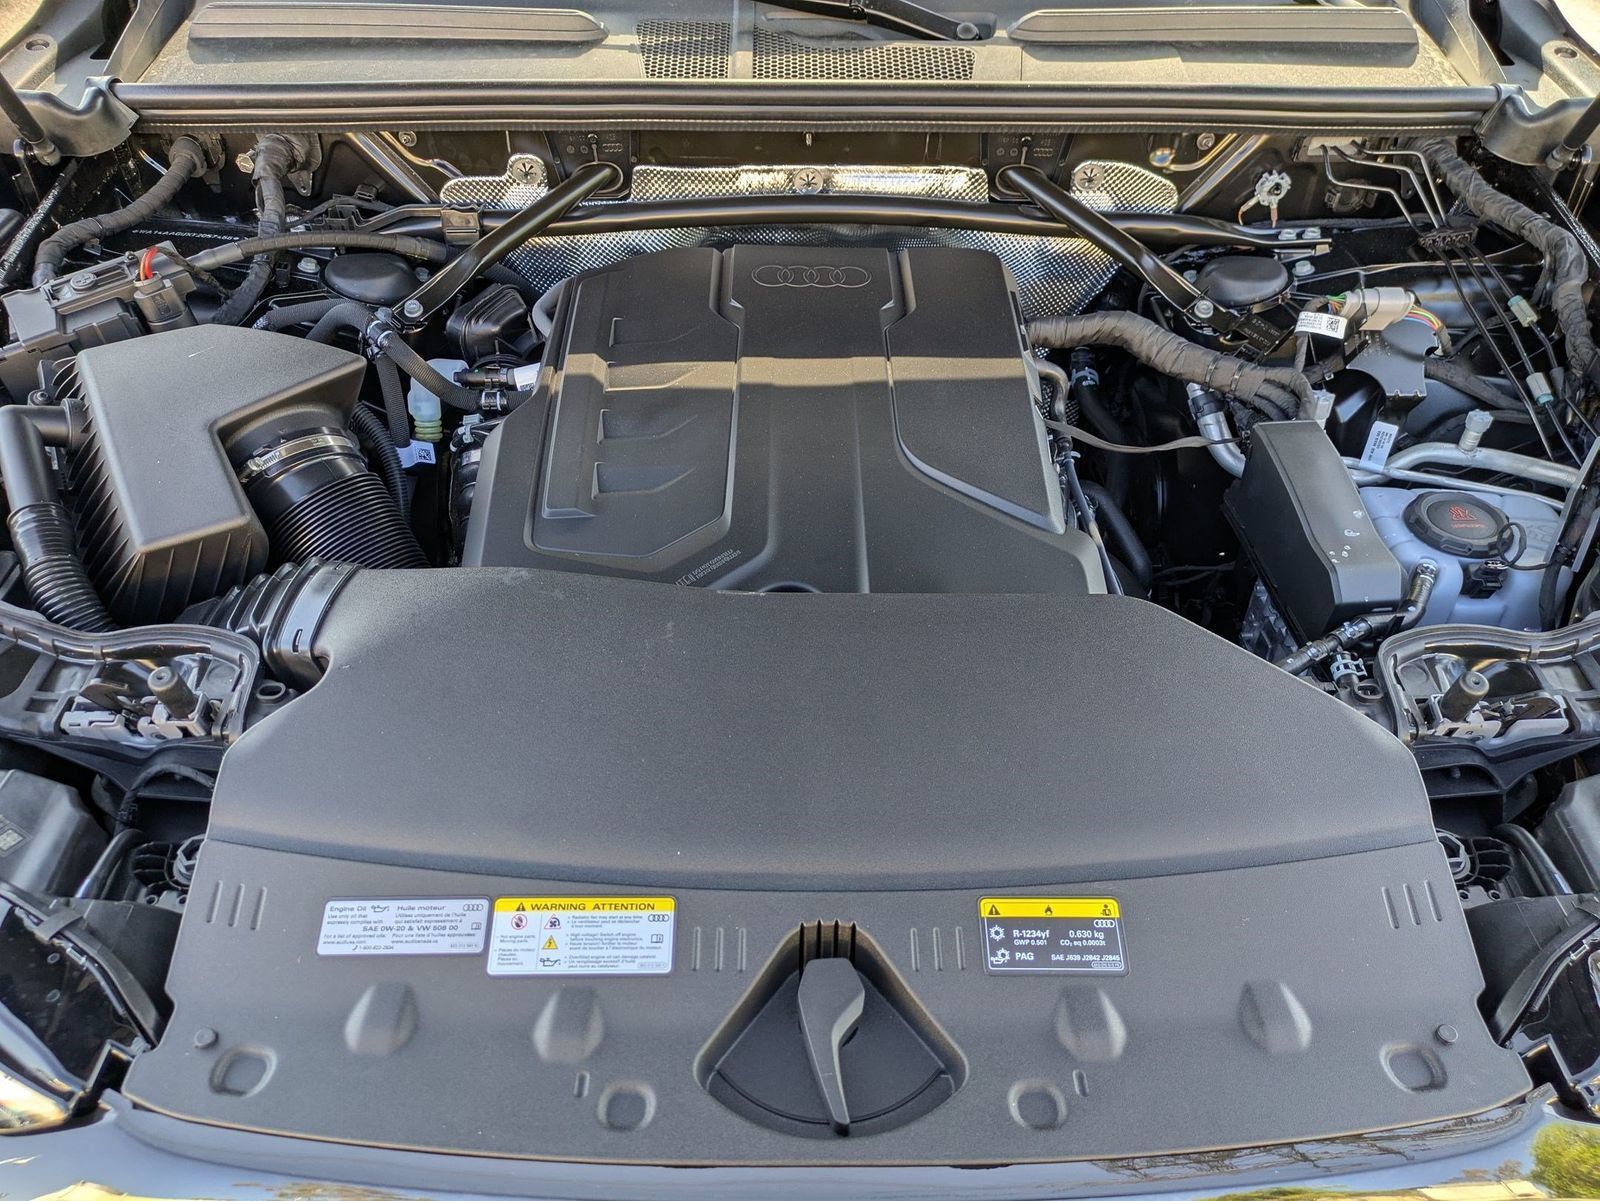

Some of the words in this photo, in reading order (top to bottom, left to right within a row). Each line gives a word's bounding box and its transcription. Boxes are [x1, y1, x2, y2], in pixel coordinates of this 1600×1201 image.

[1013, 930, 1050, 939] R-1234yf
[1069, 930, 1092, 938] 0.630
[1094, 930, 1104, 940] kg
[1015, 952, 1034, 960] PAG
